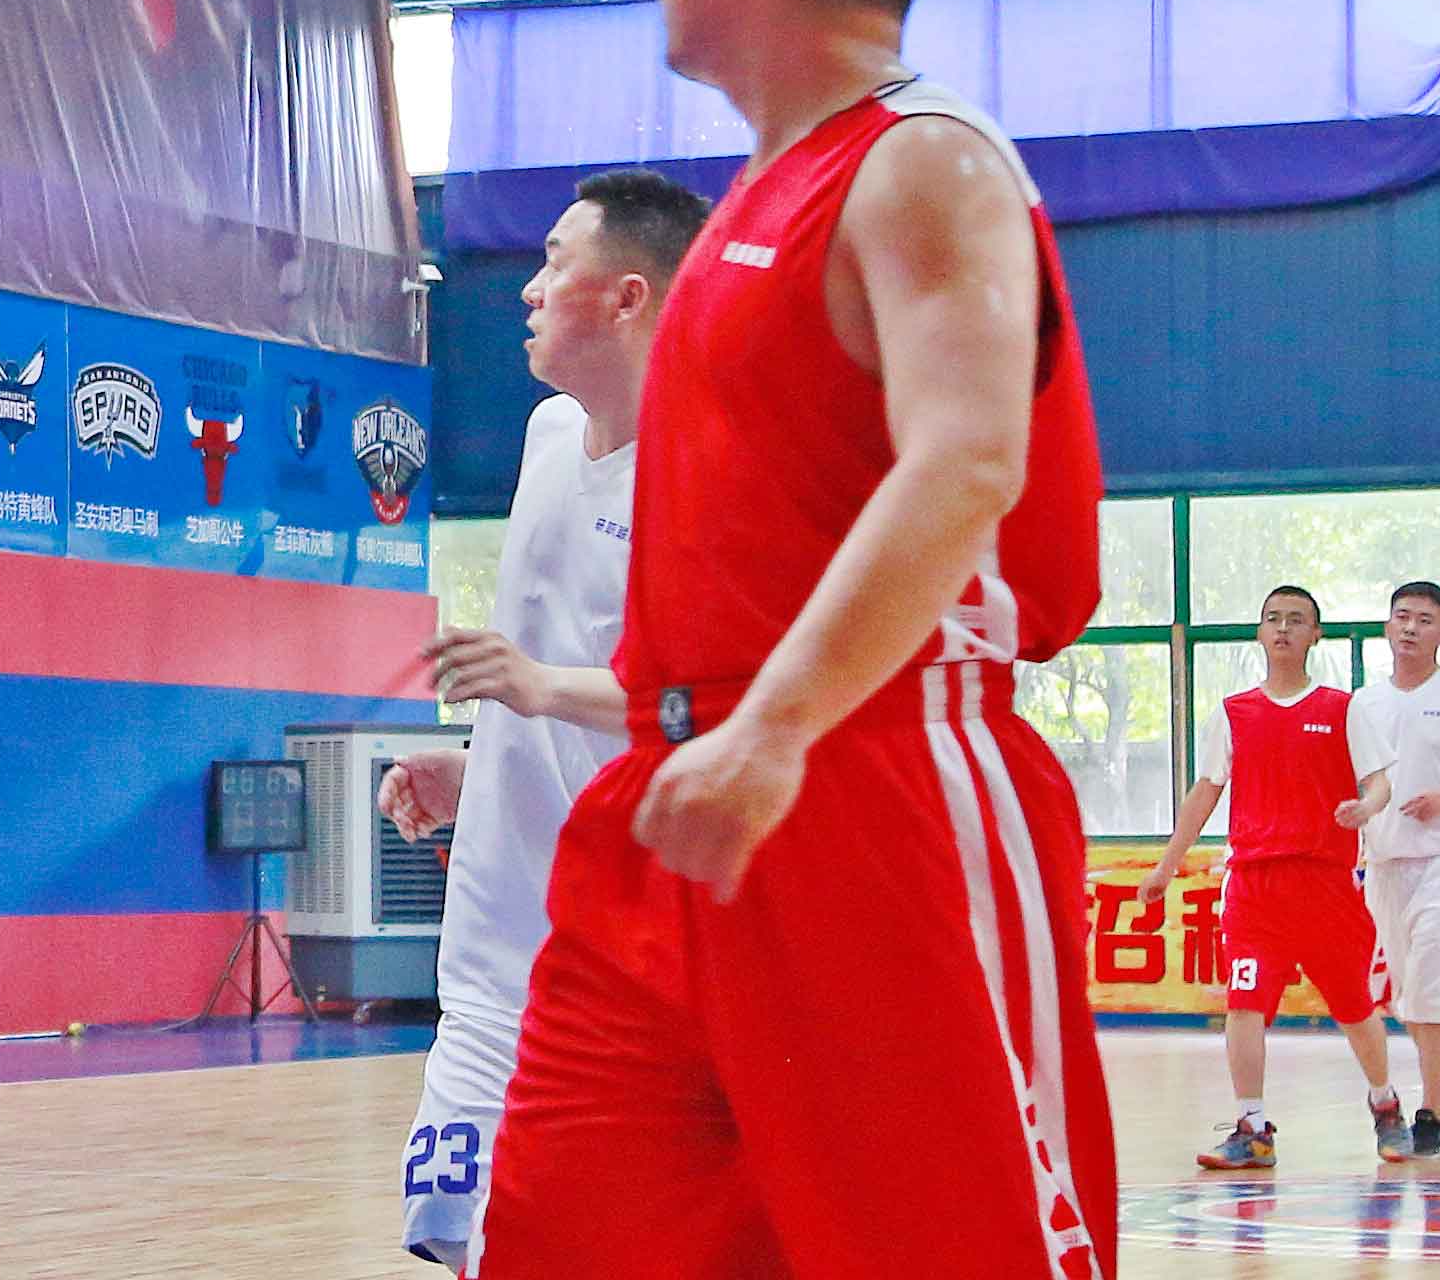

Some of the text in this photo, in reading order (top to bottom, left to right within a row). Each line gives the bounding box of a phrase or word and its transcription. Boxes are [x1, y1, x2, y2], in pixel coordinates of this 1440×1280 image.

[105, 370, 150, 394] ANTONIO
[81, 391, 152, 437] SPURS
[352, 410, 427, 465] NEW ORLEANS
[1230, 957, 1258, 992] 13
[404, 1121, 481, 1199] 23
